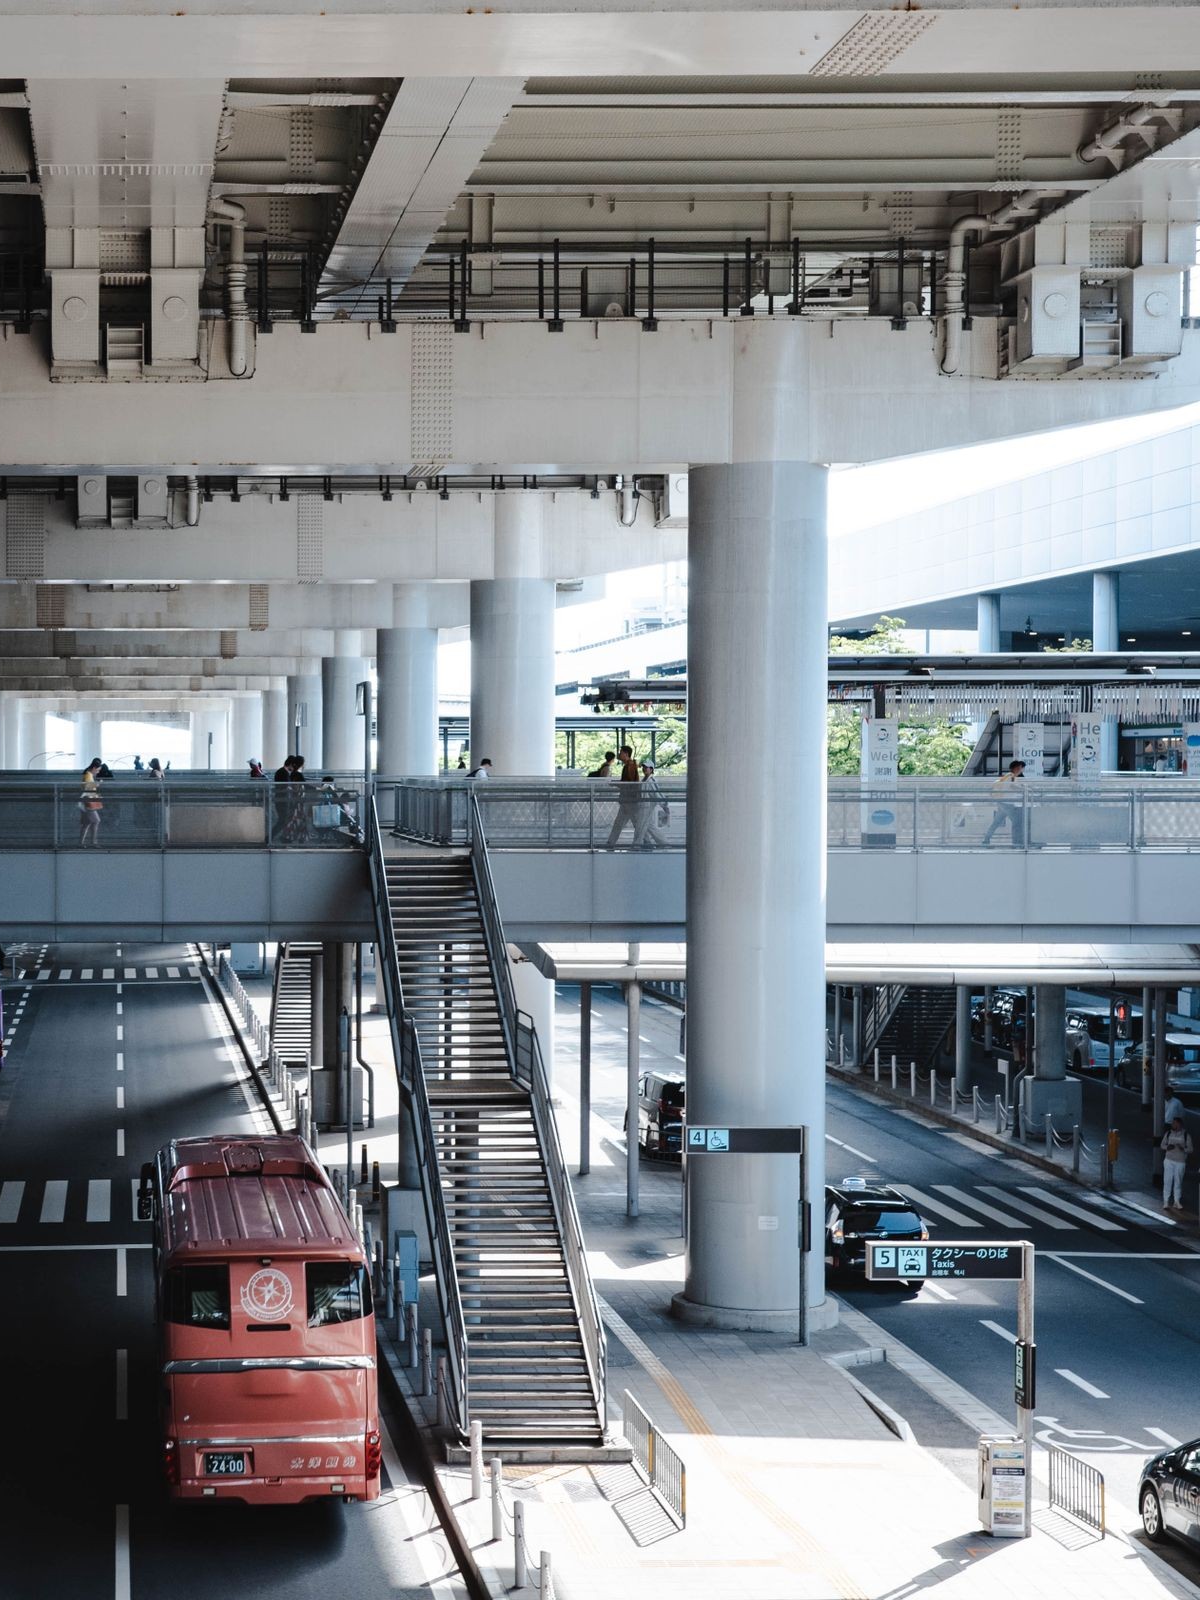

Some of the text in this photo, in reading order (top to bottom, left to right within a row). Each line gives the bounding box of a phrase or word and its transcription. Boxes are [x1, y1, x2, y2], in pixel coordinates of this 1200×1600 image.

[693, 1131, 701, 1142] 4
[880, 1250, 890, 1265] 5
[901, 1249, 924, 1257] TAXI
[931, 1247, 1009, 1259] タクシーのりば
[932, 1260, 955, 1268] Taxis
